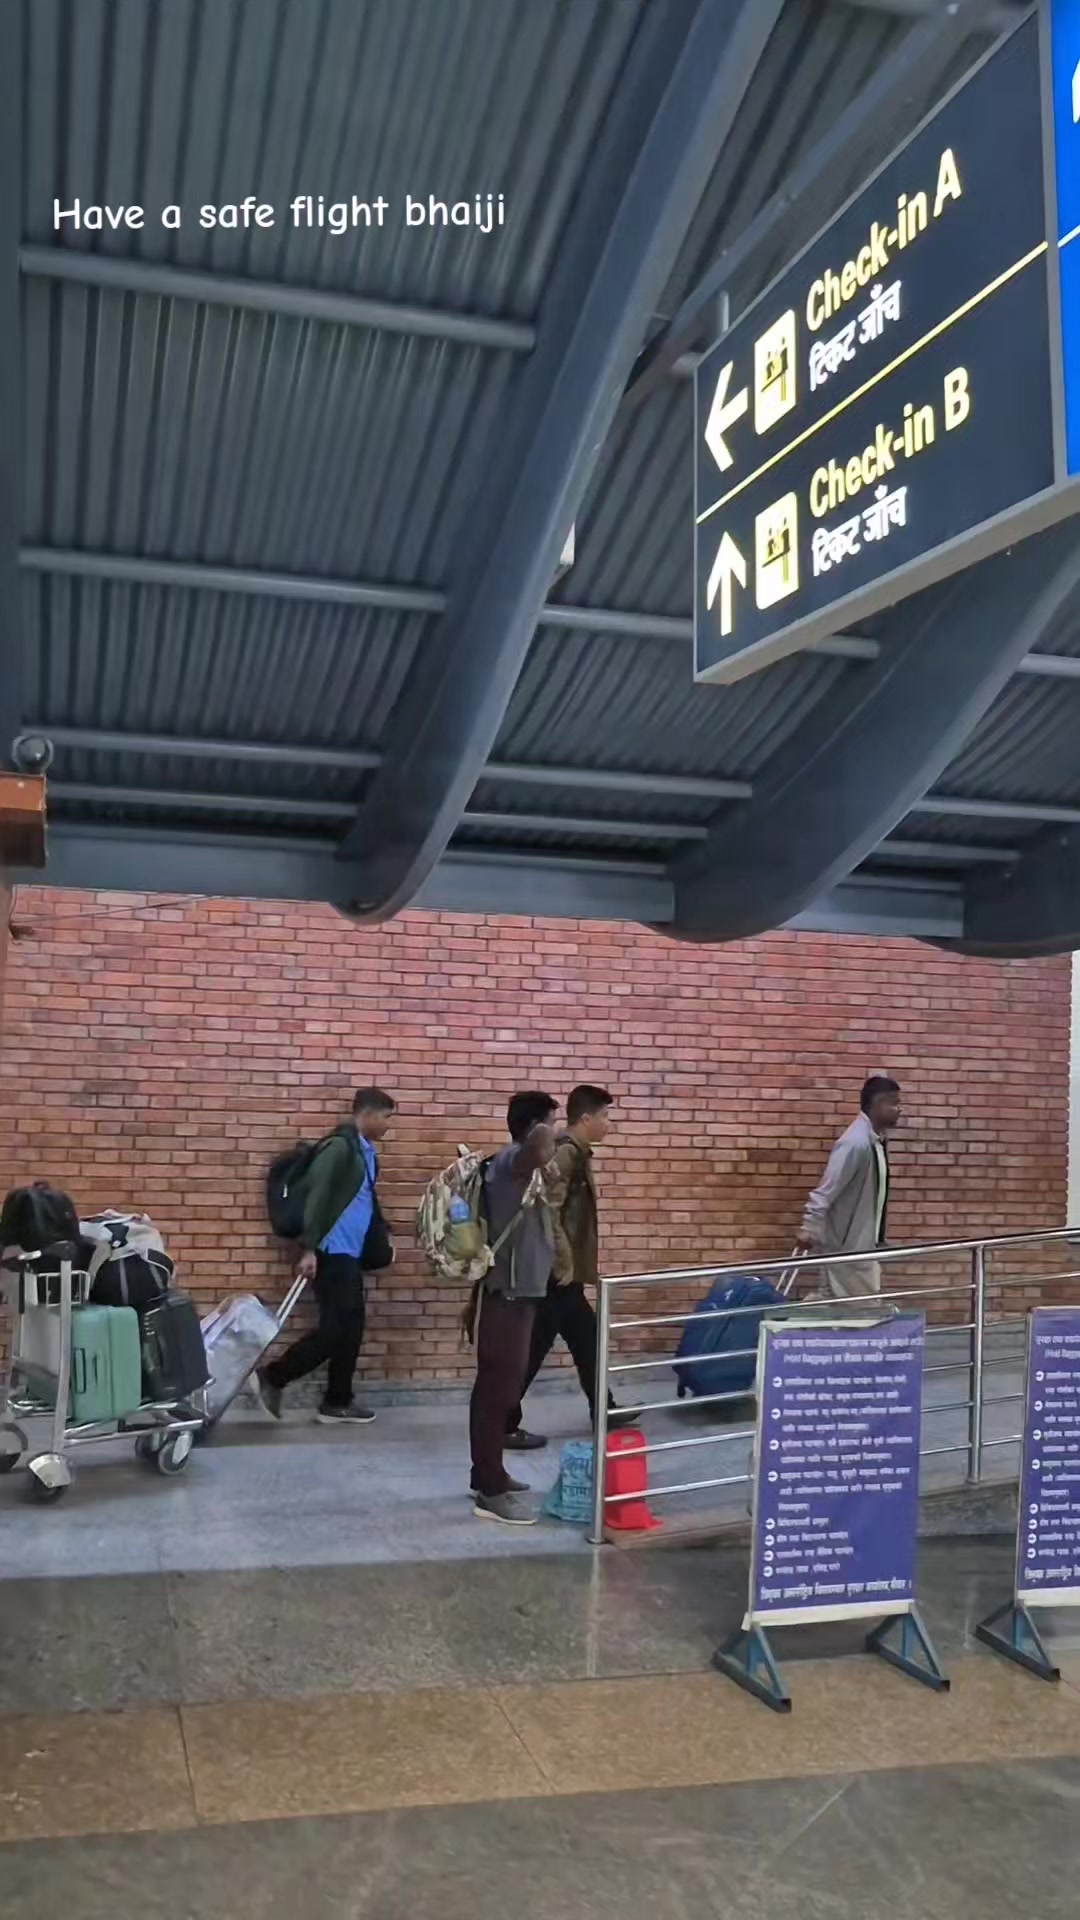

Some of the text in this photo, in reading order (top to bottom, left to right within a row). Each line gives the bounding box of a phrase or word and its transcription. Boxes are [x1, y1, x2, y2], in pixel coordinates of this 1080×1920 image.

[806, 148, 962, 332] Check-in A
[809, 280, 903, 392] टिकट जाँच
[809, 366, 971, 518] Check-in B
[811, 485, 908, 577] टिकट जाँच
